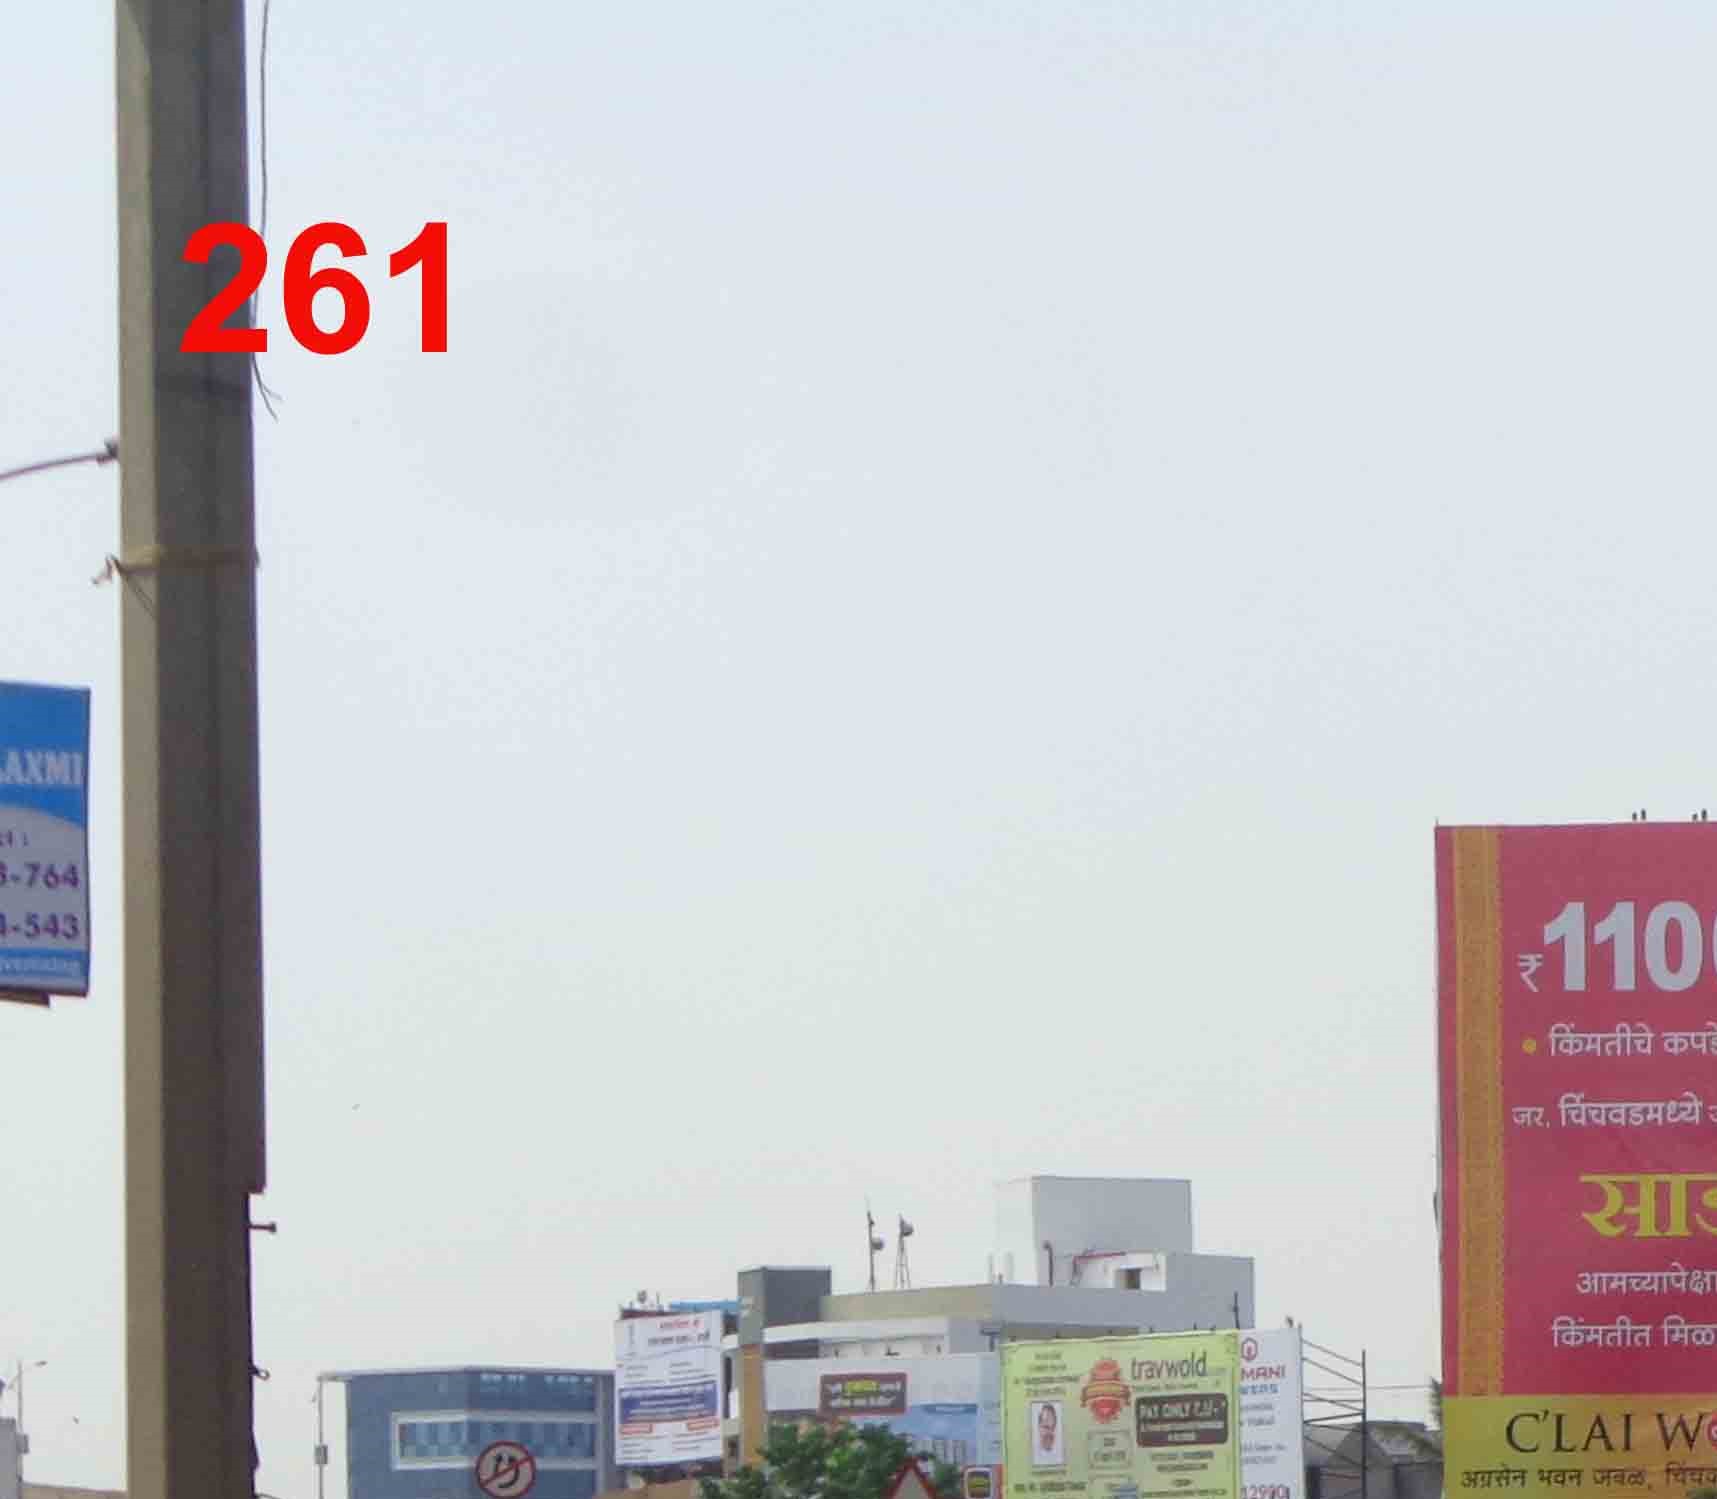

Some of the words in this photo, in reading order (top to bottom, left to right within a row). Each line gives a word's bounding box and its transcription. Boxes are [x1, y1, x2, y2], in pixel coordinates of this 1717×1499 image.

[0, 751, 82, 785] AXMI
[1549, 1023, 1655, 1057] किंमतीचे
[1558, 1091, 1704, 1127] चिंचवडमध्ये
[1552, 1315, 1652, 1348] किंमतीत
[1504, 1408, 1633, 1454] C'LAI
[1461, 1465, 1528, 1489] अग्रसेन
[1537, 1467, 1583, 1488] भवन
